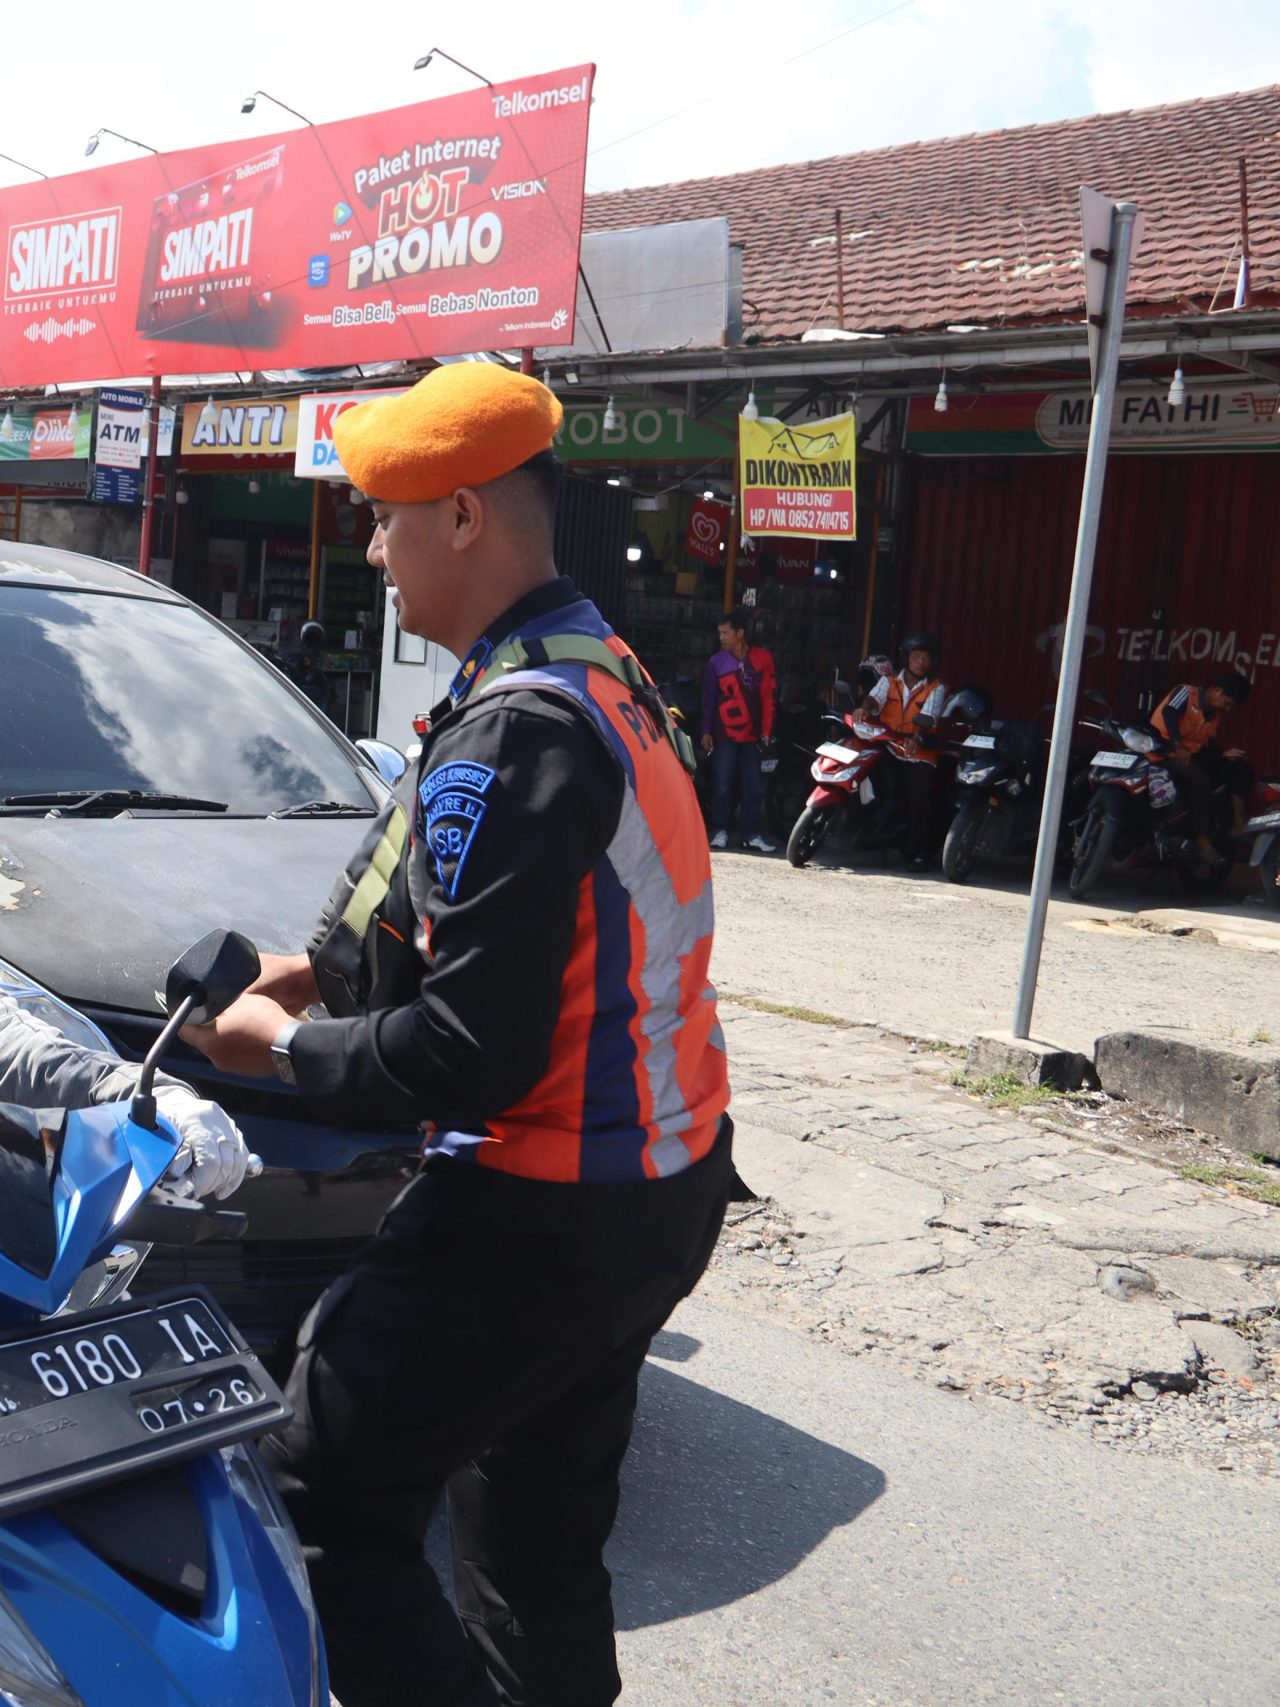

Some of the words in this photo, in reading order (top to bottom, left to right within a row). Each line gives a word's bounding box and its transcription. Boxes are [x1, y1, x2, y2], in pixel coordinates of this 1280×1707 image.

[492, 77, 588, 118] Telkomsel
[354, 151, 410, 193] Paket
[415, 136, 501, 166] Internet
[377, 167, 470, 238] HOT
[160, 207, 253, 282] SIMPATI
[329, 230, 352, 242] WeTV
[347, 212, 503, 290] PROMO
[10, 215, 117, 293] SIMPATI
[4, 300, 51, 315] TERBAIK
[58, 292, 116, 308] UNTUKMU
[154, 286, 193, 301] TERBAIK
[199, 276, 252, 293] UNTUKMU
[304, 313, 331, 325] Semua
[333, 306, 362, 326] Bisa
[397, 304, 426, 315] Semua
[429, 293, 474, 316] Bebas
[478, 287, 539, 309] Nonton
[101, 392, 117, 402] AITO
[118, 395, 143, 406] MOBILE
[1122, 393, 1220, 424] FATHI
[100, 413, 114, 421] MINI
[191, 404, 287, 446] ANTI
[100, 423, 140, 444] ATM
[776, 492, 833, 507] HUBUNGI
[750, 508, 766, 526] HP
[788, 509, 814, 528] 0852
[434, 827, 463, 856] SB
[30, 1333, 142, 1398] 6180
[158, 1313, 222, 1364] IA
